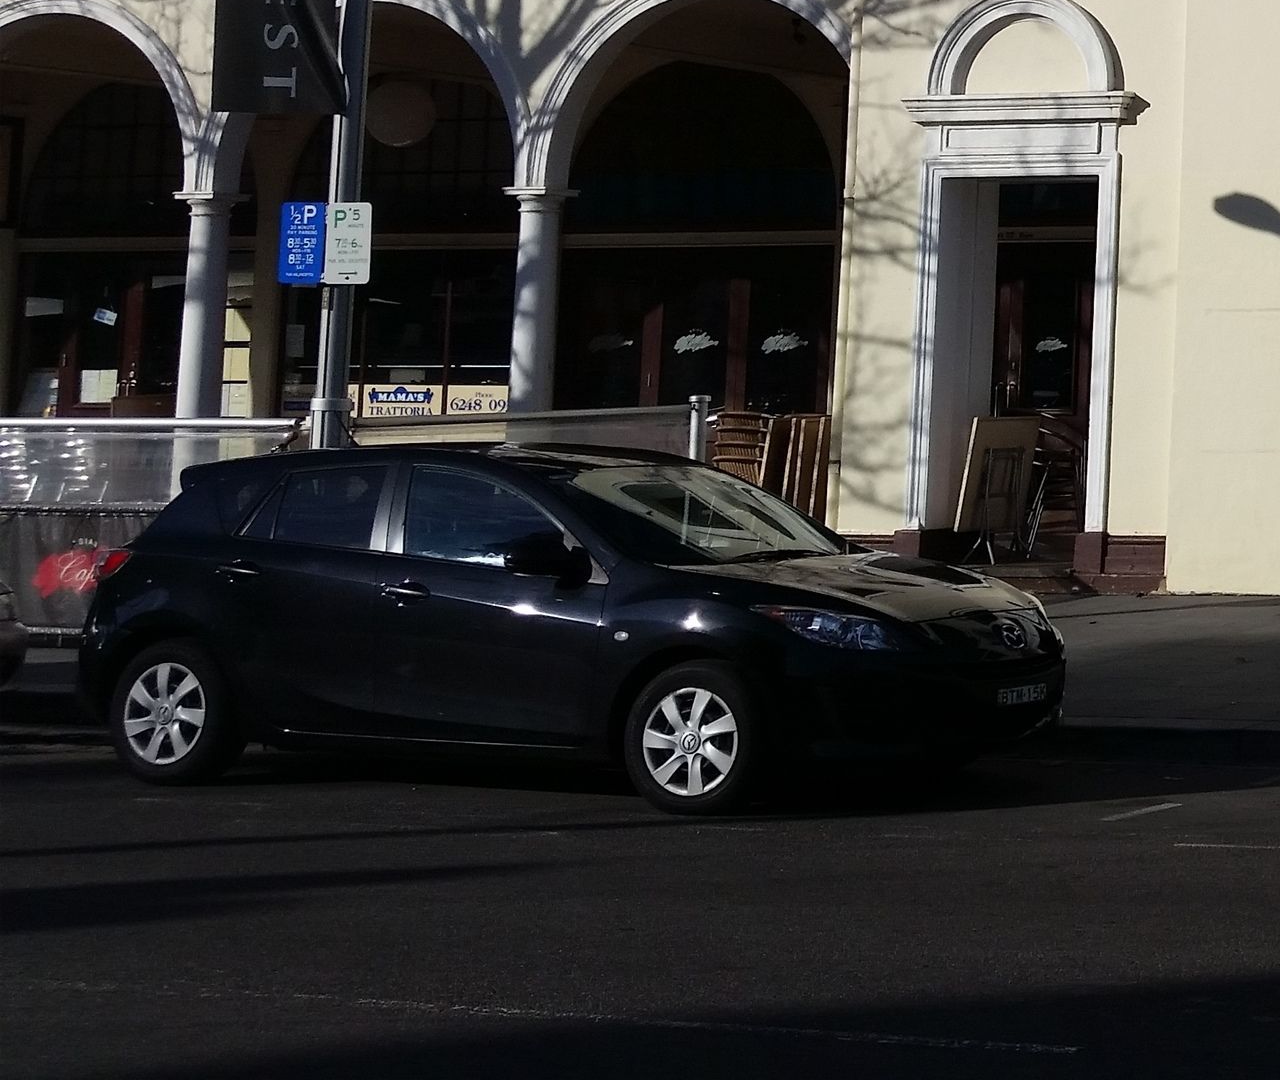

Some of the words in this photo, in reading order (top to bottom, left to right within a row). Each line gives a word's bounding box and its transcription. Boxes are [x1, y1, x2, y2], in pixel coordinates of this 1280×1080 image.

[352, 208, 361, 221] 5
[377, 392, 425, 403] MAMA'S
[368, 405, 433, 416] TRATTORIA
[450, 397, 482, 412] 6248
[488, 398, 507, 412] 09
